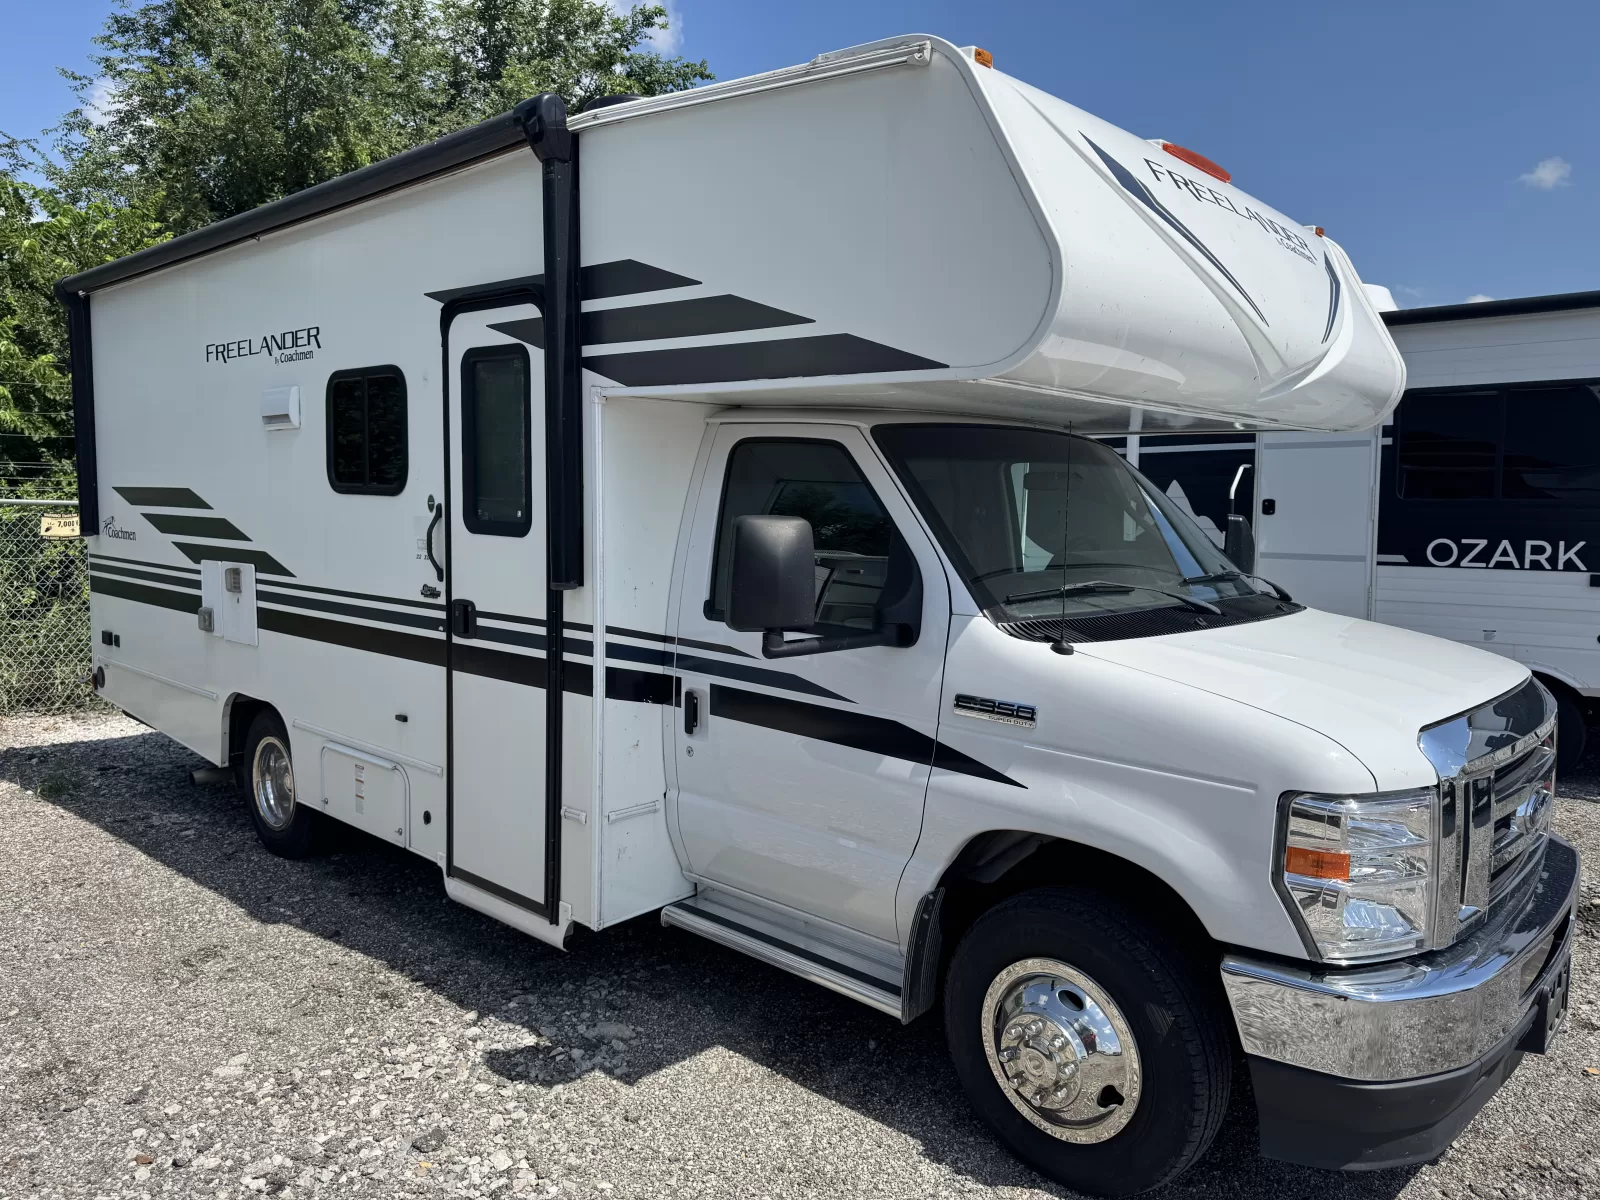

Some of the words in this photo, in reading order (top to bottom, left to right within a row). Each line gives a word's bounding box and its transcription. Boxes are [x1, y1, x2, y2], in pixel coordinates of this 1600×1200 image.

[1143, 157, 1318, 261] FREELANDER
[206, 326, 321, 363] FREELANDER
[280, 350, 314, 363] Coachmen
[107, 527, 137, 541] Coachmen
[1426, 538, 1588, 571] OZARK
[988, 715, 1012, 725] SUPER
[1013, 720, 1033, 728] DUTY
